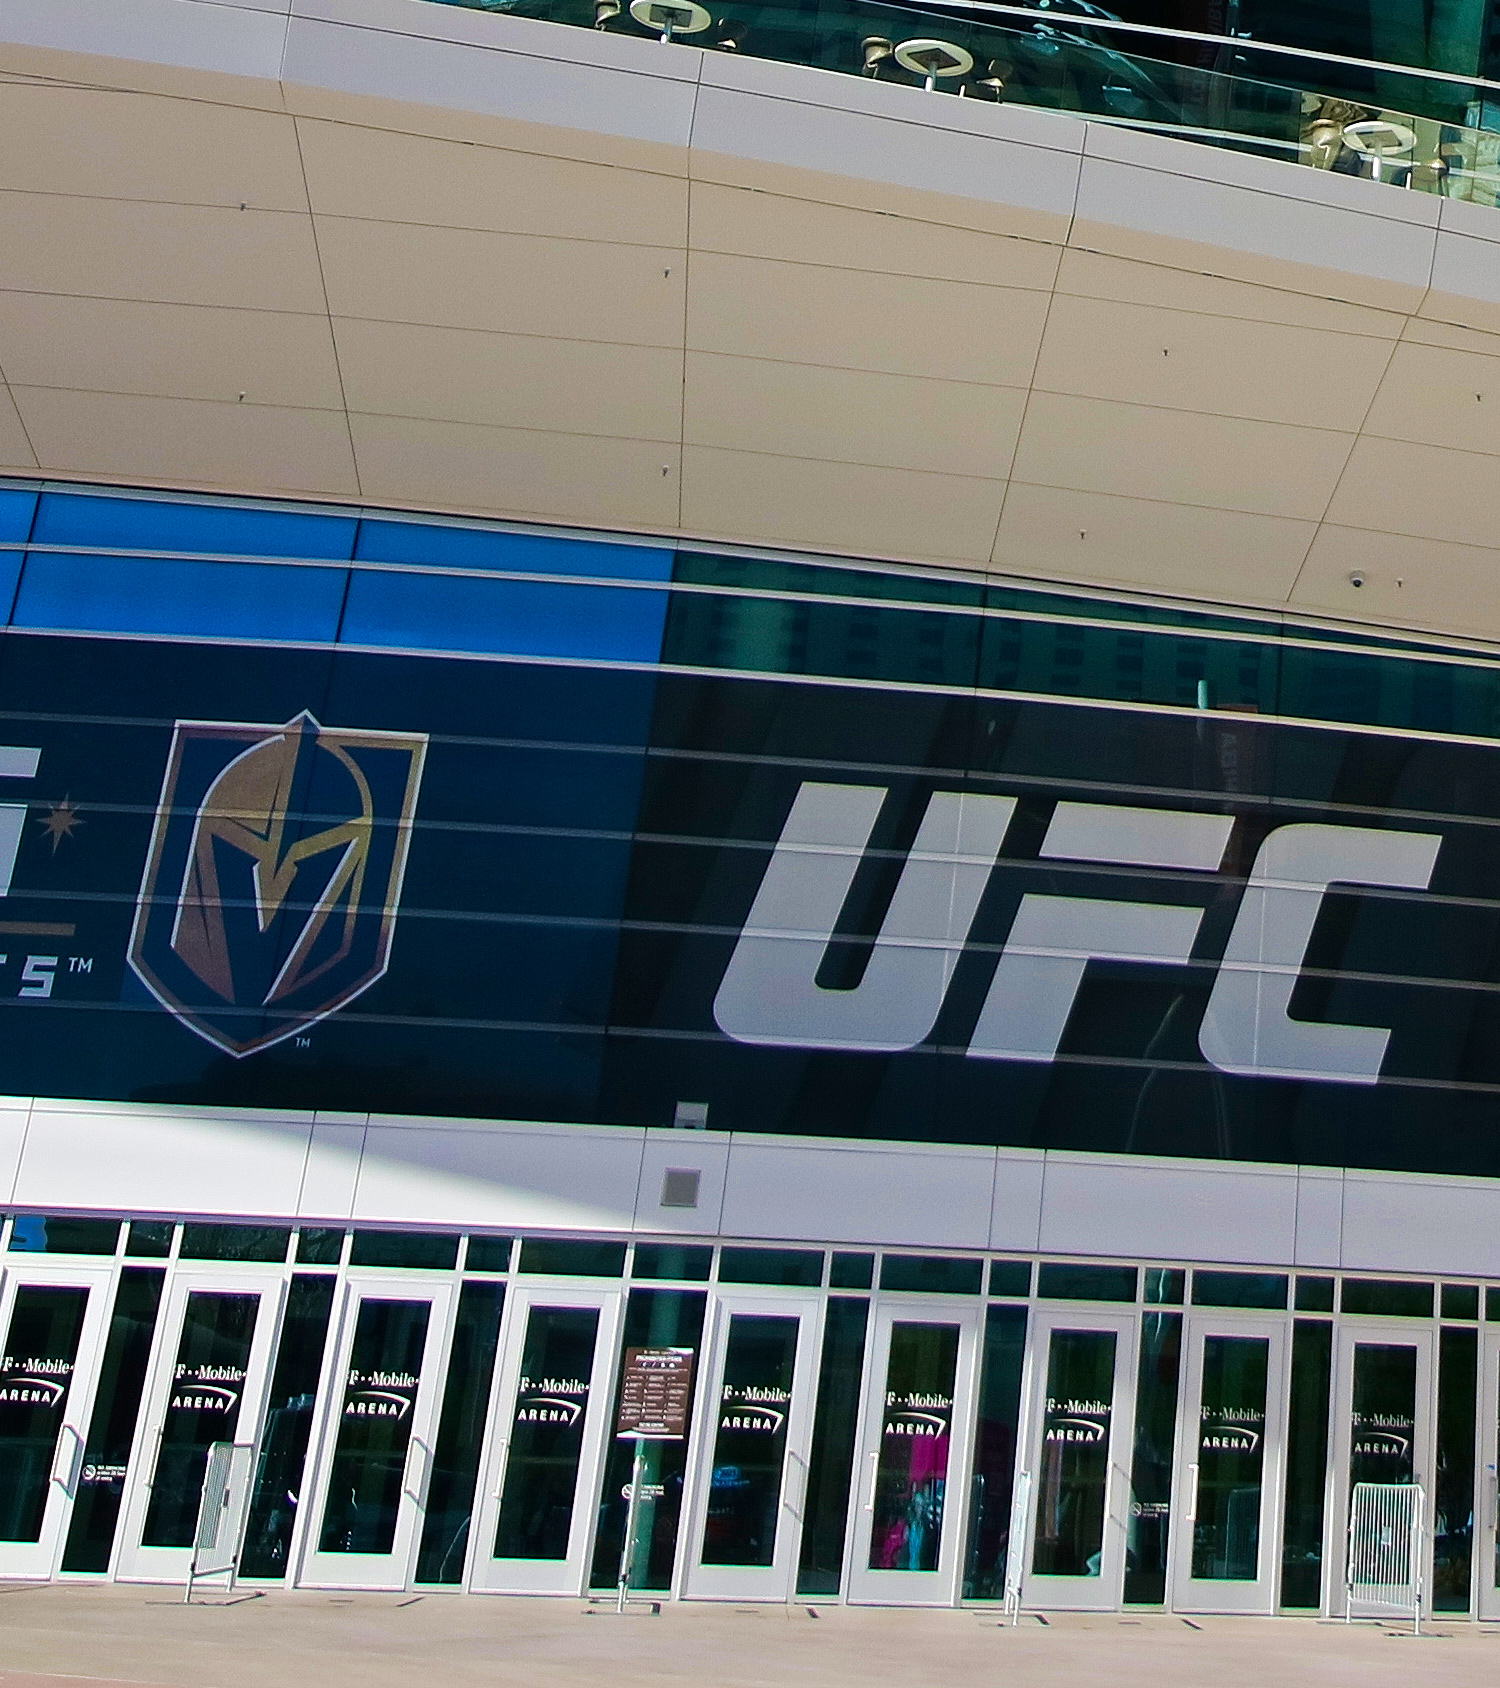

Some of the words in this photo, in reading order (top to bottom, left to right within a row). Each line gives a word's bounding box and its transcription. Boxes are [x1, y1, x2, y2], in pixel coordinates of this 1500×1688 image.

[712, 780, 1443, 1086] UFC
[171, 1395, 224, 1410] ARENA
[345, 1401, 398, 1416] ARENA
[517, 1408, 569, 1422] ARENA
[721, 1416, 772, 1430] ARENA
[885, 1422, 935, 1436] ARENA
[1046, 1428, 1094, 1442] ARENA
[1202, 1436, 1249, 1449] ARENA
[1354, 1441, 1399, 1454] ARENA
